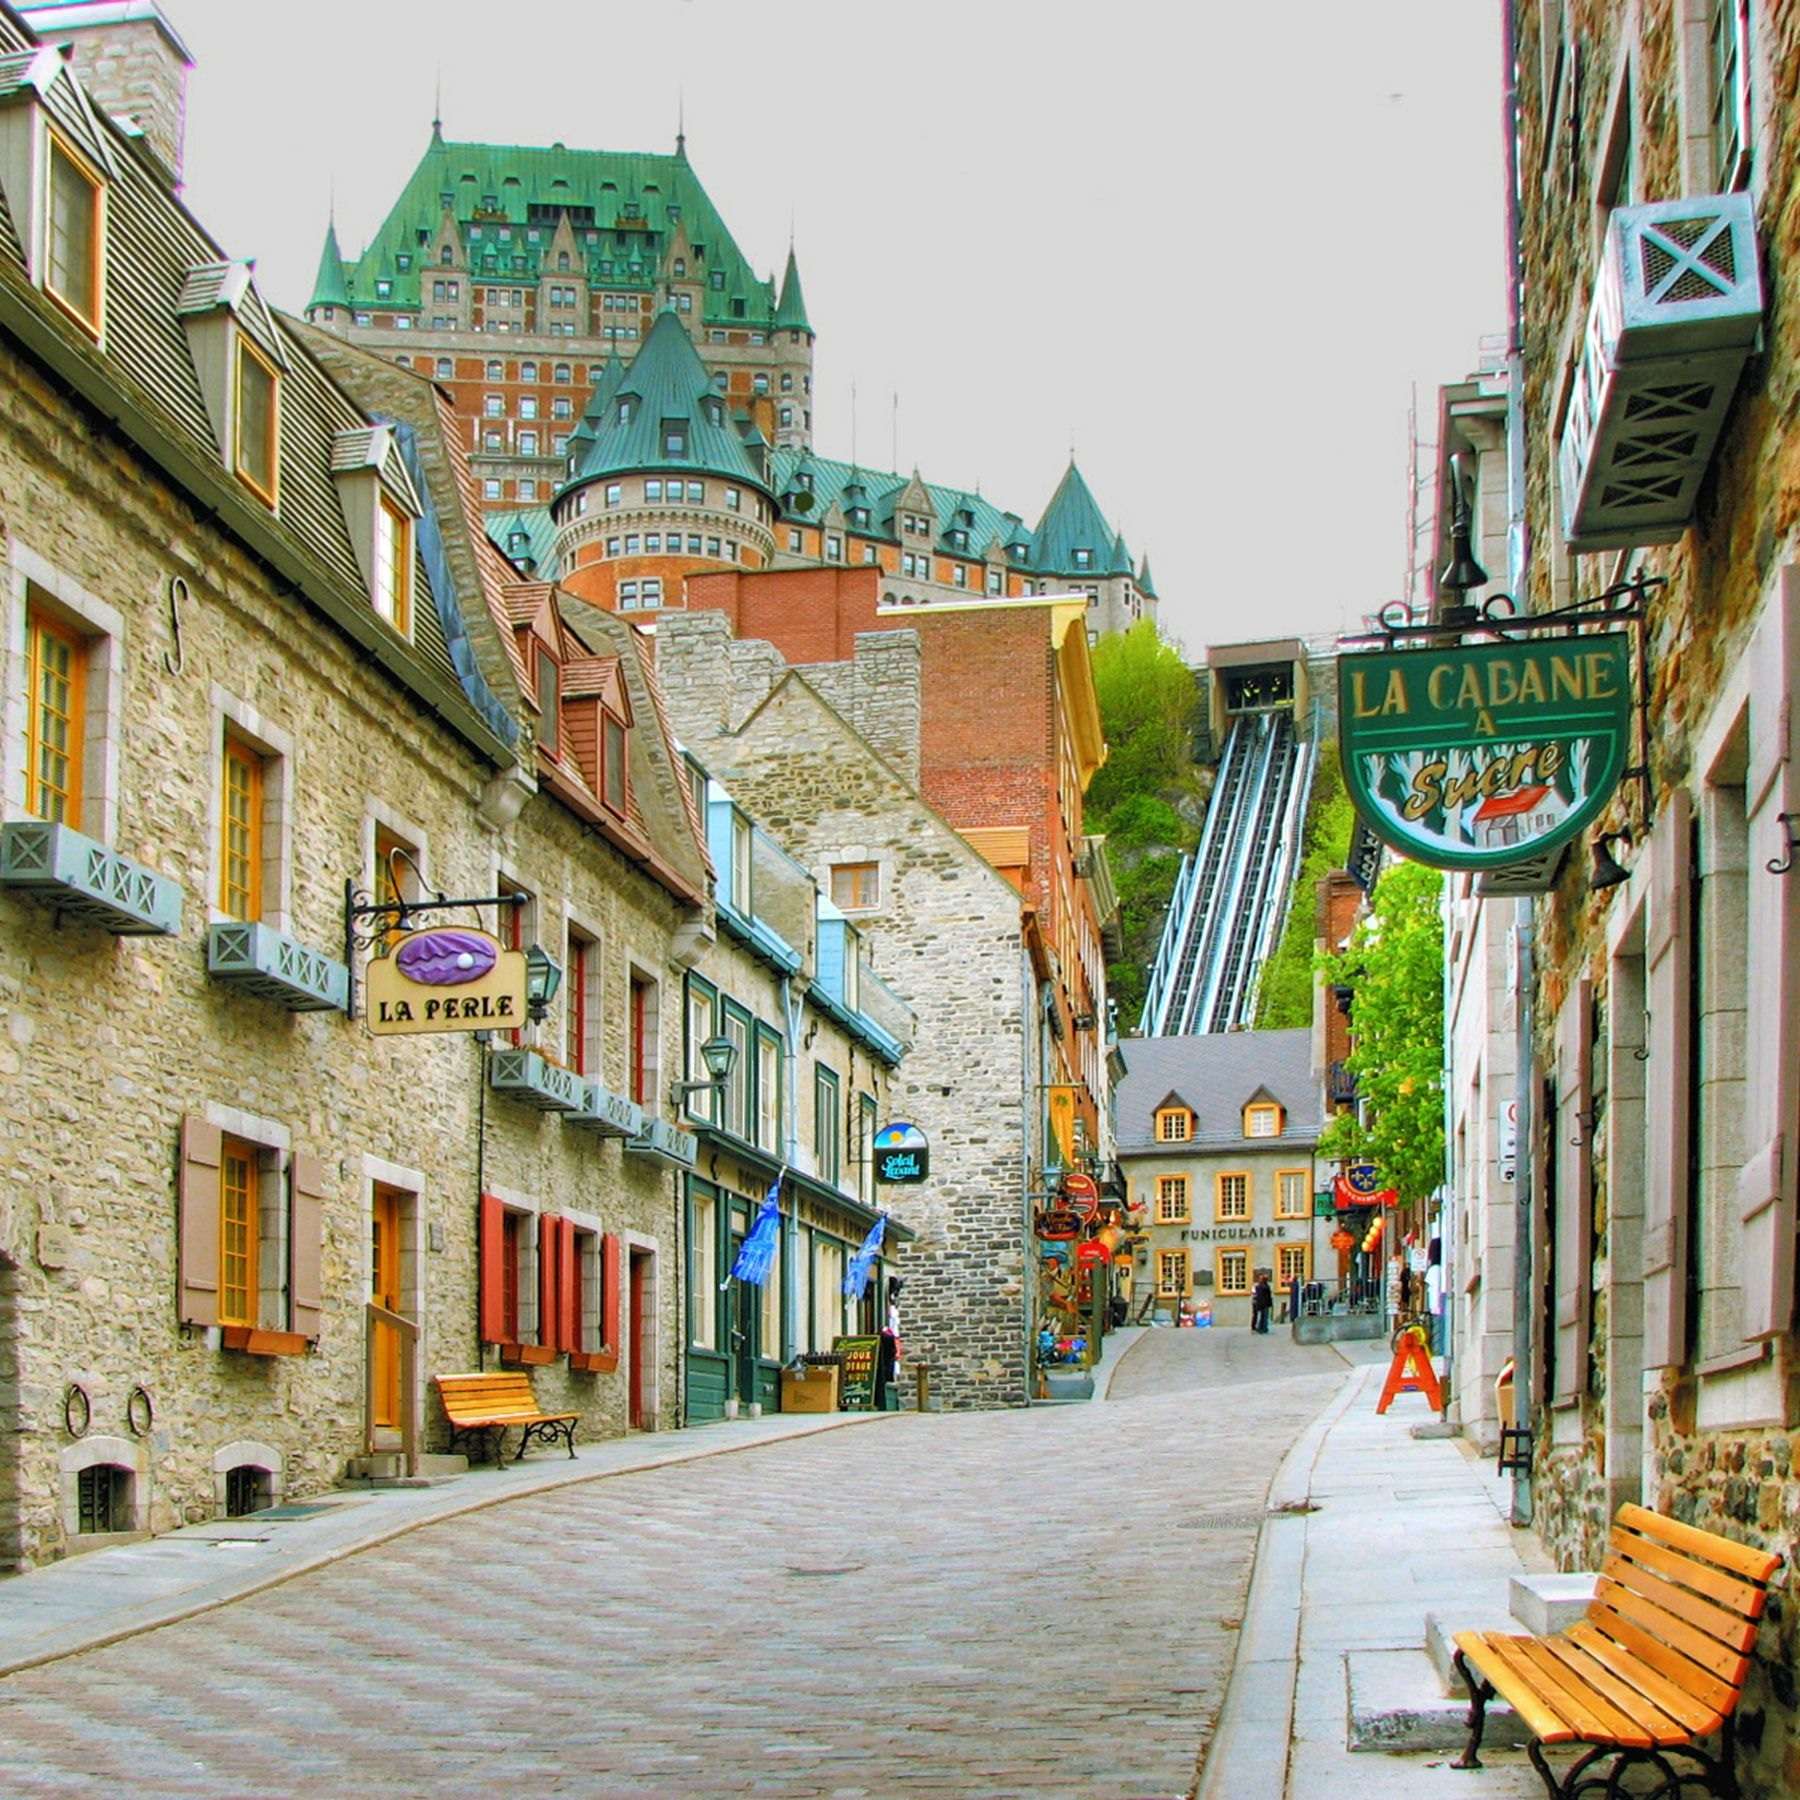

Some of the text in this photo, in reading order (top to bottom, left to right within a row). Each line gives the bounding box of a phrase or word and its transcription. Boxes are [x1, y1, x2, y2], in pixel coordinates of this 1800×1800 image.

[1352, 652, 1618, 718] LA CABANE
[1403, 743, 1564, 820] Sucre
[379, 995, 514, 1022] LA PERLE
[1181, 1226, 1286, 1241] FUNICULAIRE
[847, 1351, 872, 1360] JOUX
